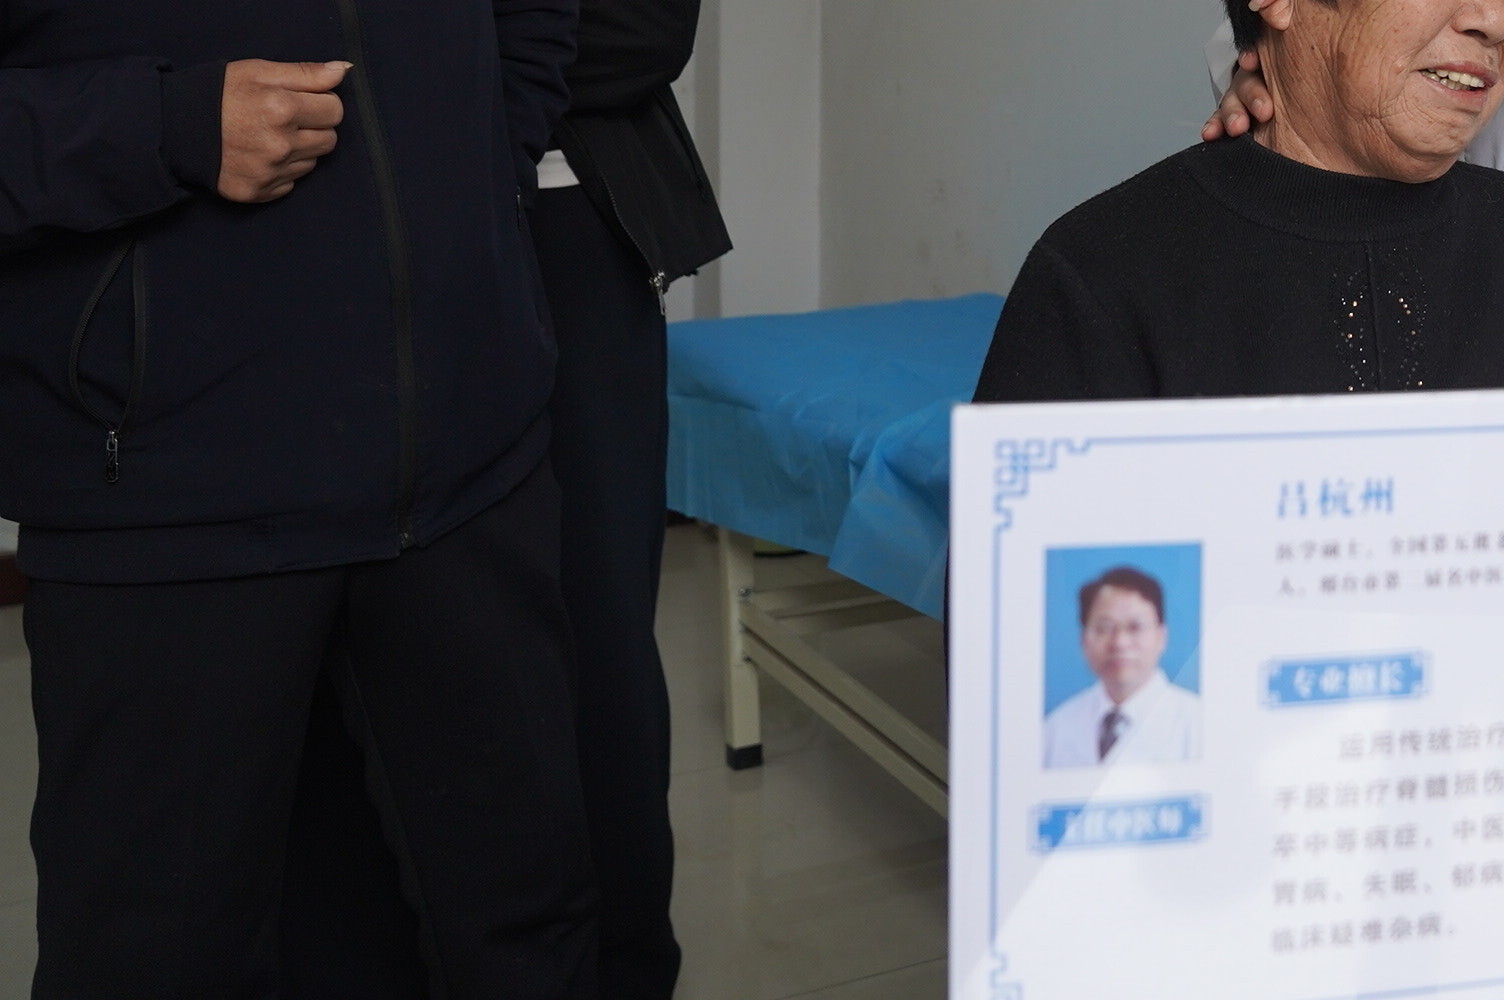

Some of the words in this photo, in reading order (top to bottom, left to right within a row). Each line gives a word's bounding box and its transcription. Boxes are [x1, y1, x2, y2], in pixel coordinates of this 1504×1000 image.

[1277, 475, 1396, 519] 吕杭州
[1292, 660, 1405, 699] 专业擅长
